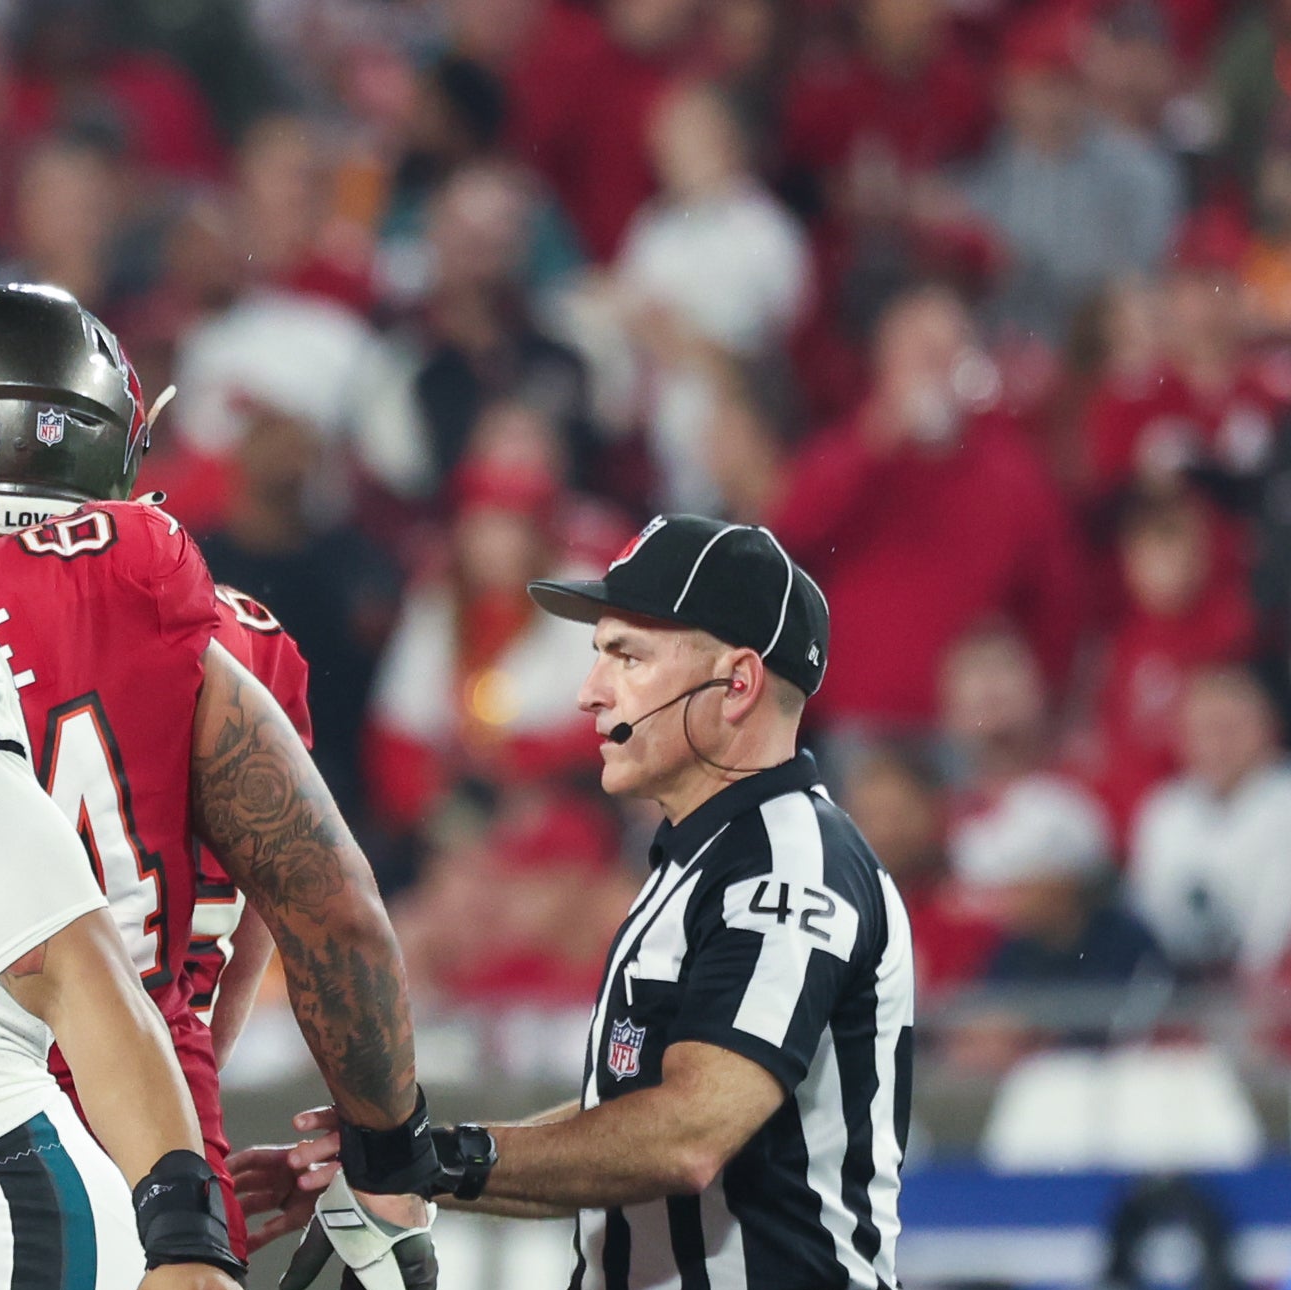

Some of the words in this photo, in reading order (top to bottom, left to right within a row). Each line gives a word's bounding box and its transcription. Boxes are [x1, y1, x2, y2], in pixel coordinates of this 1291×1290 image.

[41, 425, 61, 439] NFL
[5, 511, 53, 527] LOV
[748, 880, 836, 943] 42
[609, 1043, 636, 1073] NFL
